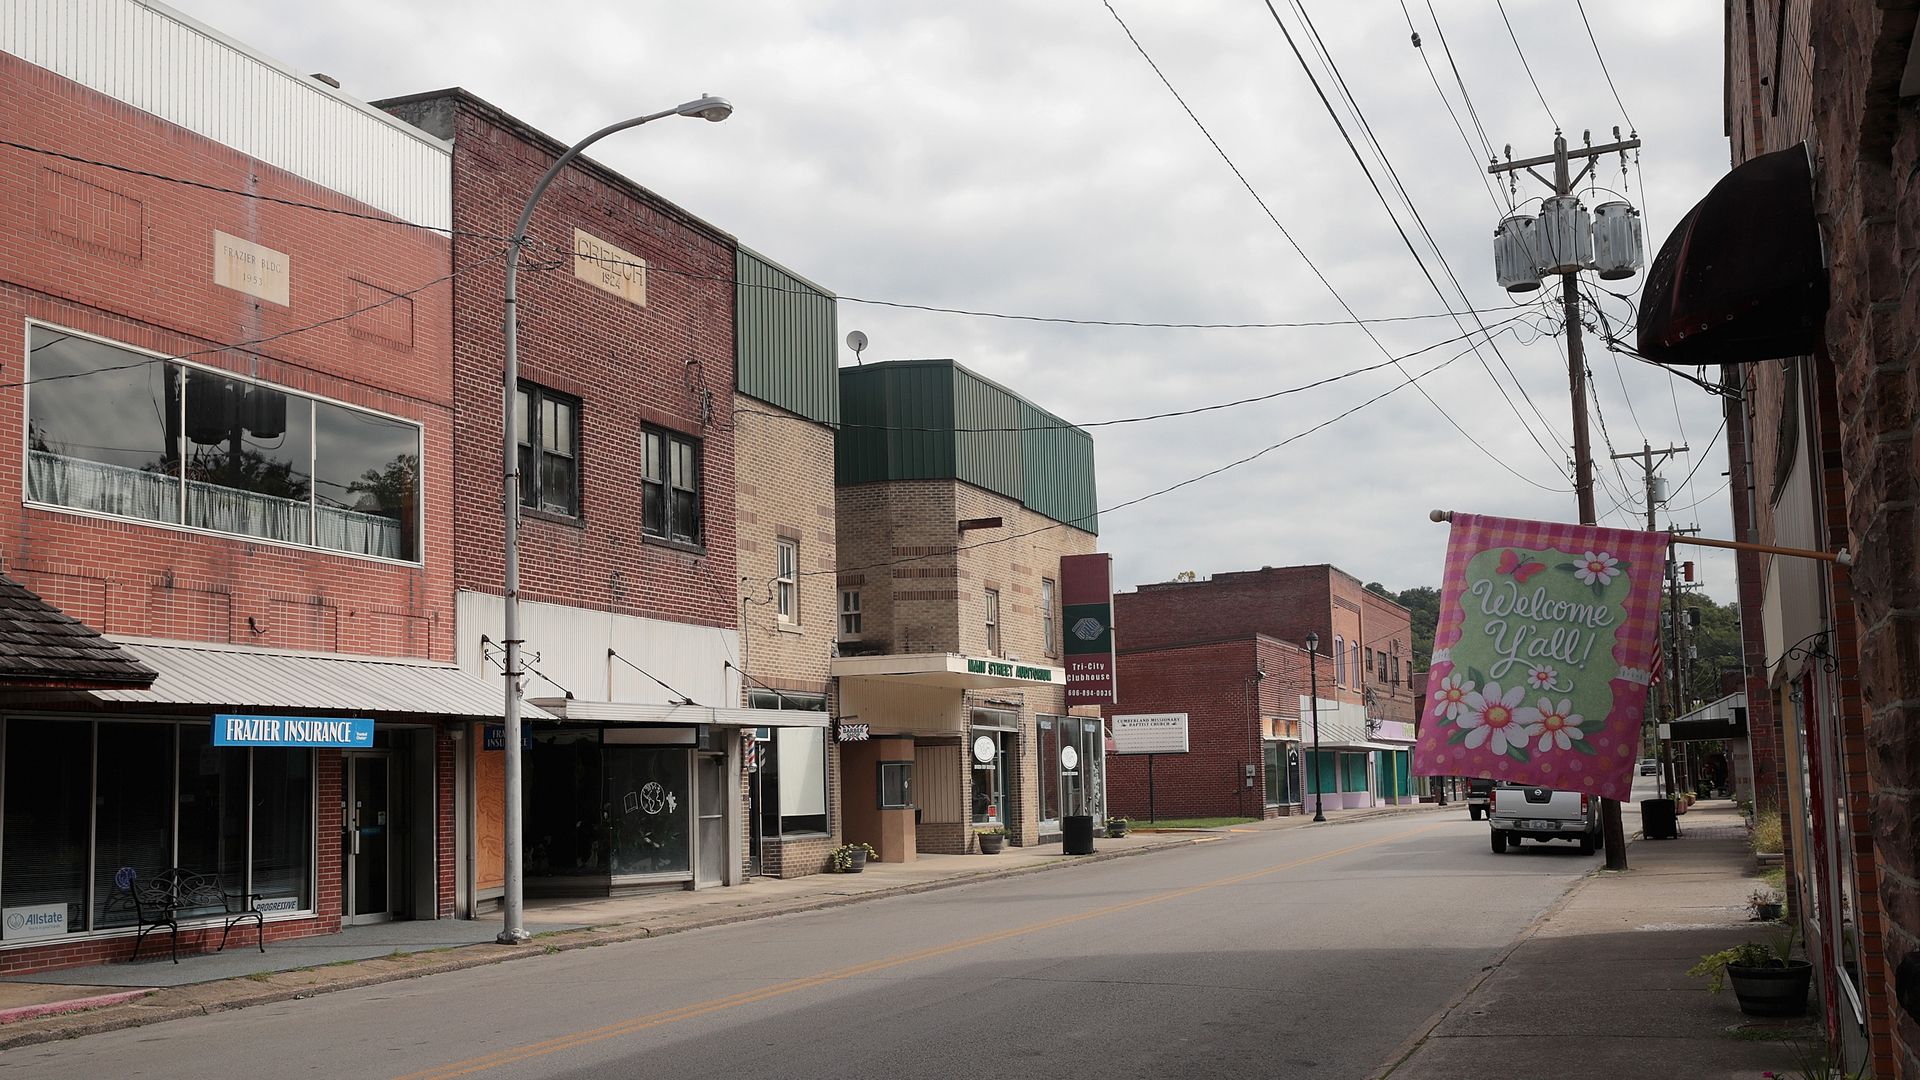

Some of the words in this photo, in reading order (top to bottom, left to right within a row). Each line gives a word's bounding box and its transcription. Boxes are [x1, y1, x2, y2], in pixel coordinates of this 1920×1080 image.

[223, 245, 256, 265] FRAZIER
[577, 238, 643, 287] CREECH
[243, 272, 263, 287] 1953
[1471, 578, 1615, 628] Welcome
[1484, 619, 1596, 680] Y'all!
[967, 659, 986, 674] MAIN
[988, 661, 1014, 677] STREET
[1072, 662, 1105, 671] Tri-City
[1066, 673, 1110, 682] Clubhouse
[226, 719, 280, 742] FRAZIER
[283, 720, 352, 743] INSURANCE
[256, 900, 296, 912] PROGRESSIVE
[25, 912, 63, 926] Allstate
